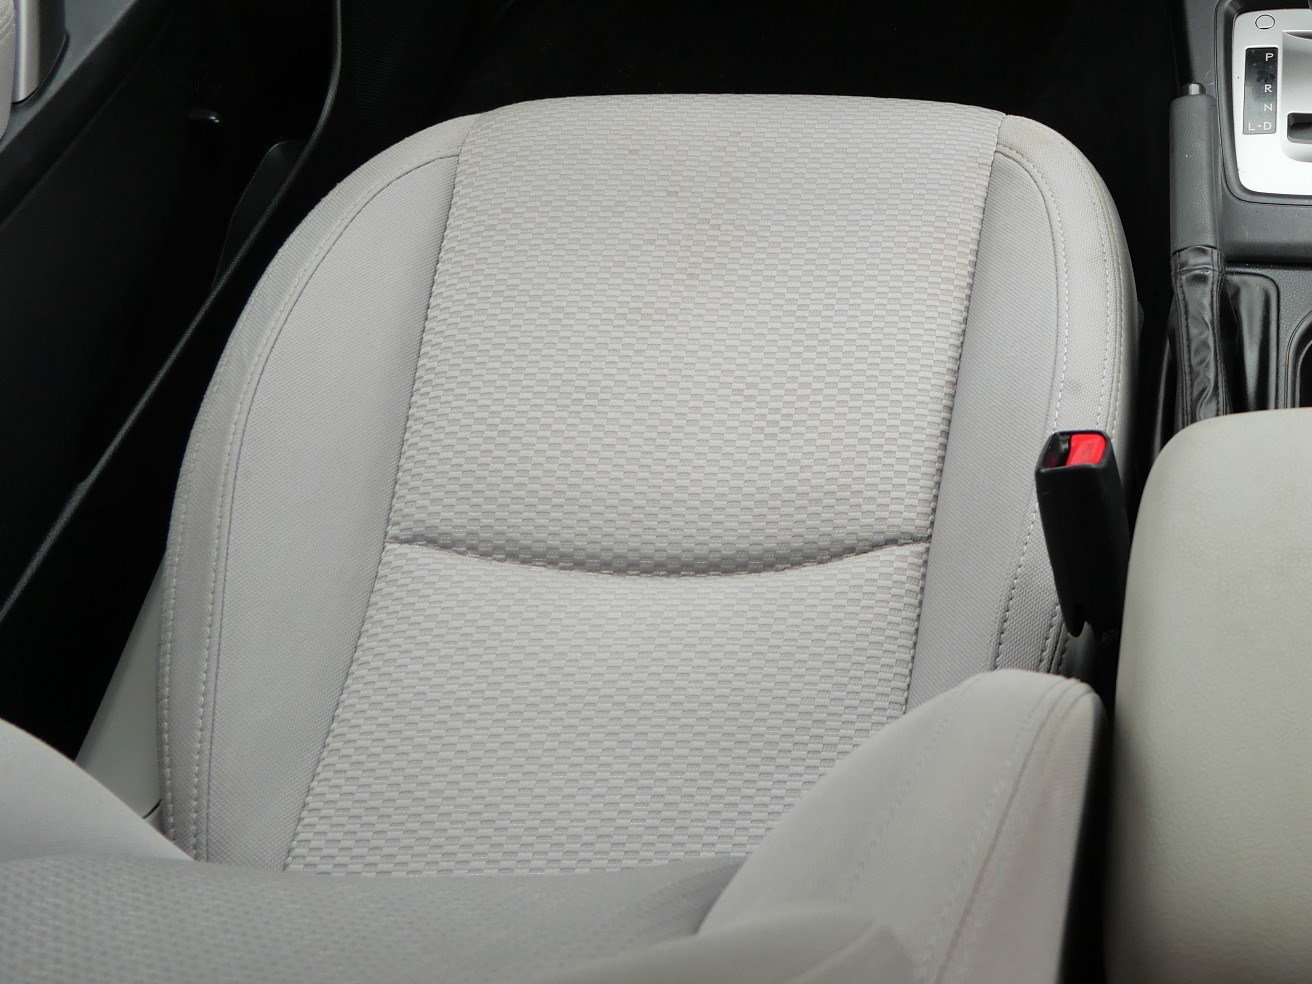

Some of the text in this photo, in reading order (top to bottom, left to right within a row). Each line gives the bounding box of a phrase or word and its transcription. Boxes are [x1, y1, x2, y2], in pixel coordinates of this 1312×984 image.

[1265, 53, 1274, 62] P
[1264, 84, 1273, 93] R
[1263, 103, 1273, 112] N
